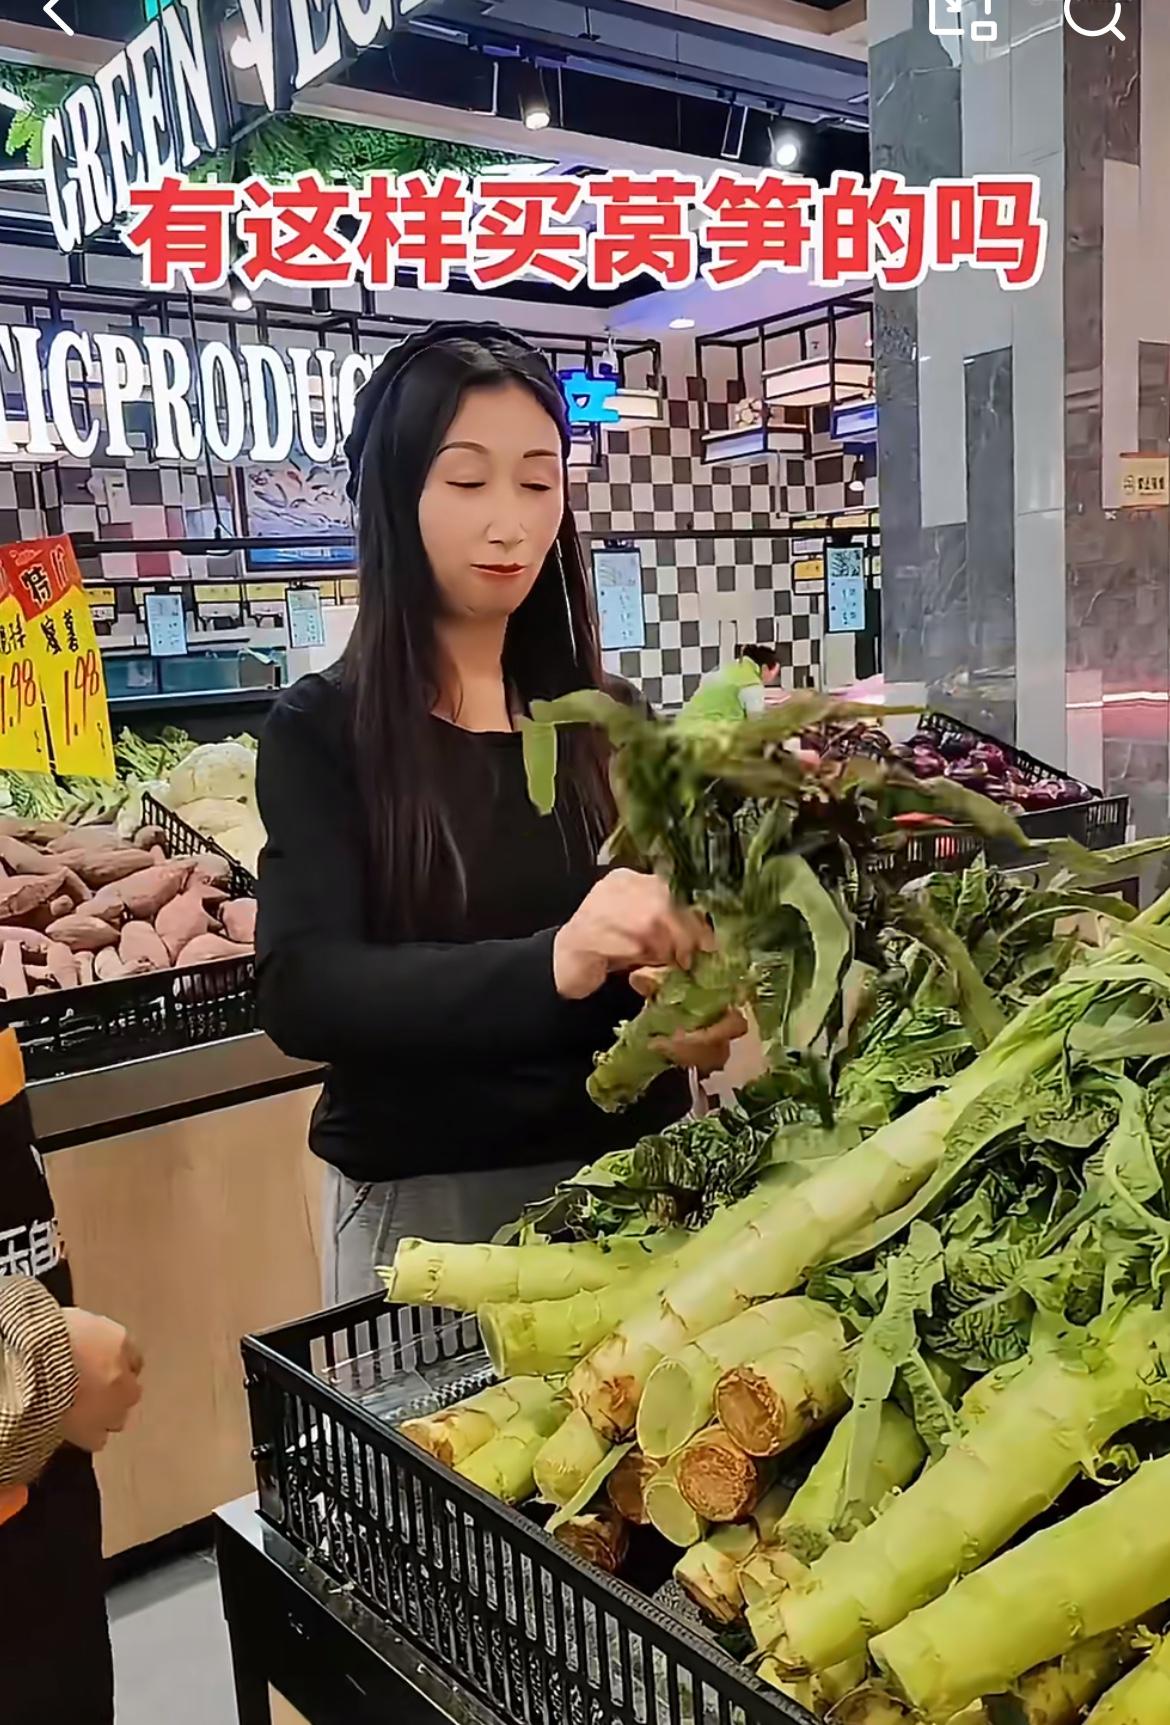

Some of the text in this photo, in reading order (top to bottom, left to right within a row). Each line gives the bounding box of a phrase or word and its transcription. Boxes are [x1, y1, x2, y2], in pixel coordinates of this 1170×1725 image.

[42, 0, 217, 253] GREEN
[0, 658, 36, 735] 1.98
[64, 649, 100, 746] 1.98
